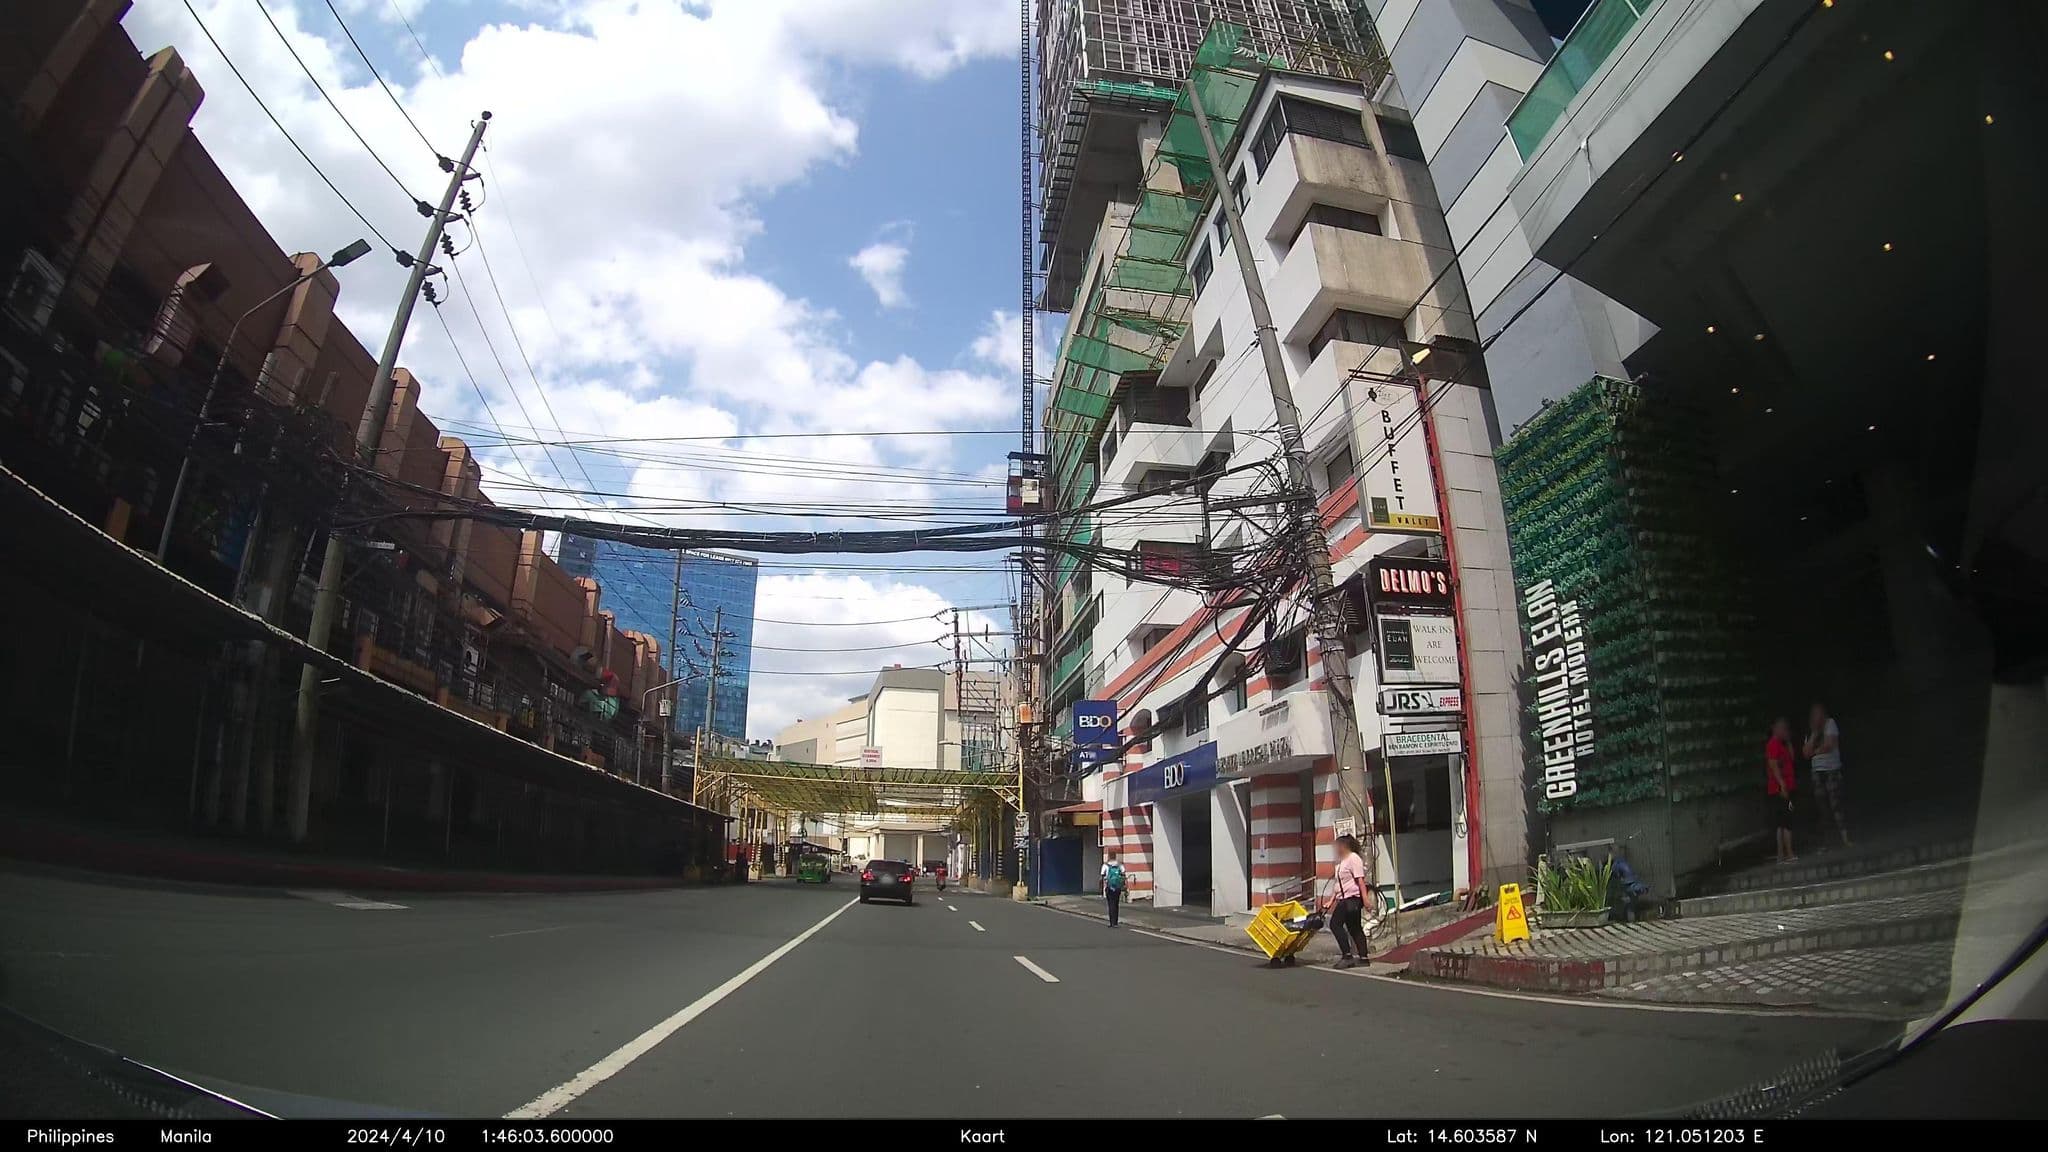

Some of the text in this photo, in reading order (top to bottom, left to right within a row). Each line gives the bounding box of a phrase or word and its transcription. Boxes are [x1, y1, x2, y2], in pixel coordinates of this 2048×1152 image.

[1381, 410, 1405, 510] BUFFET
[1380, 568, 1447, 595] DELMO'S
[1413, 625, 1437, 633] WALK
[1415, 656, 1457, 664] WELCOME
[1524, 578, 1577, 799] GREENHILLS ELAN
[1560, 600, 1595, 758] HOTEL MODERN
[1386, 692, 1420, 710] JRS
[1079, 715, 1112, 731] BDO
[1164, 762, 1184, 789] BDO
